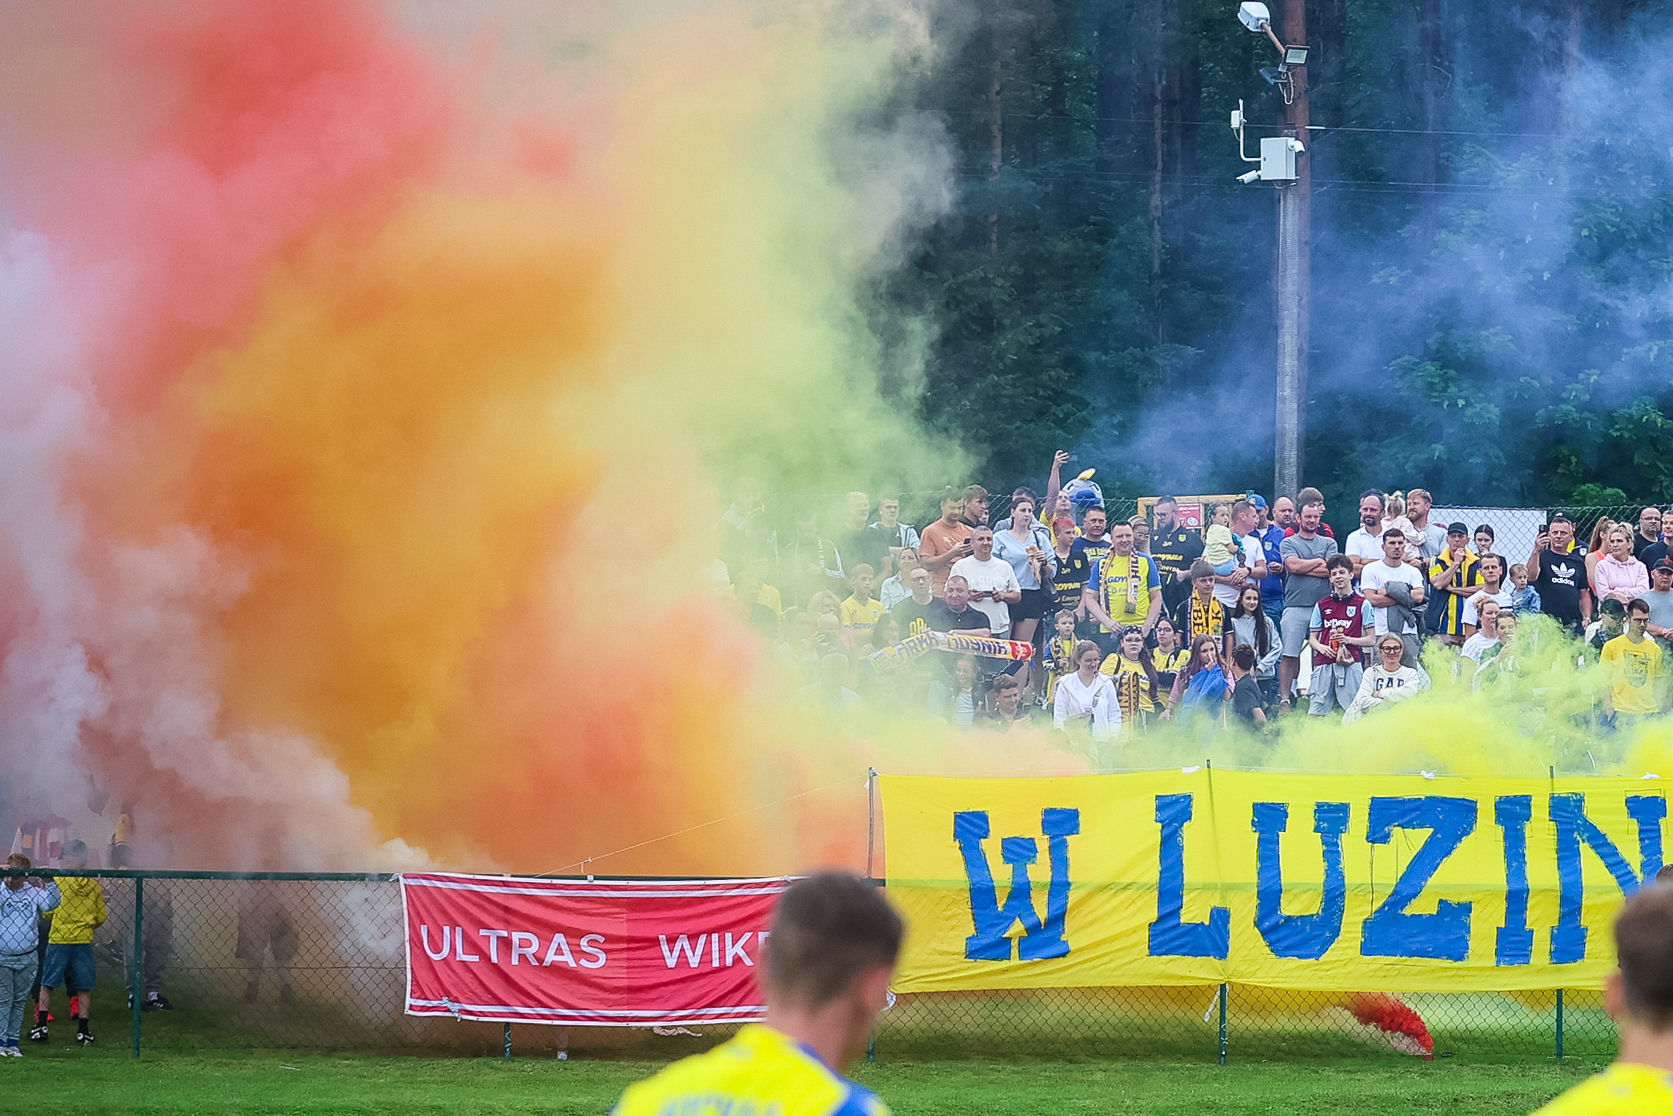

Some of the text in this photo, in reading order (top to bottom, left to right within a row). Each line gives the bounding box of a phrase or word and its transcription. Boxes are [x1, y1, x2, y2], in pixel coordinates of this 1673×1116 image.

[1551, 577, 1574, 586] adidas
[1324, 619, 1352, 628] betway
[953, 807, 1080, 961] W
[420, 924, 608, 970] ULTRAS
